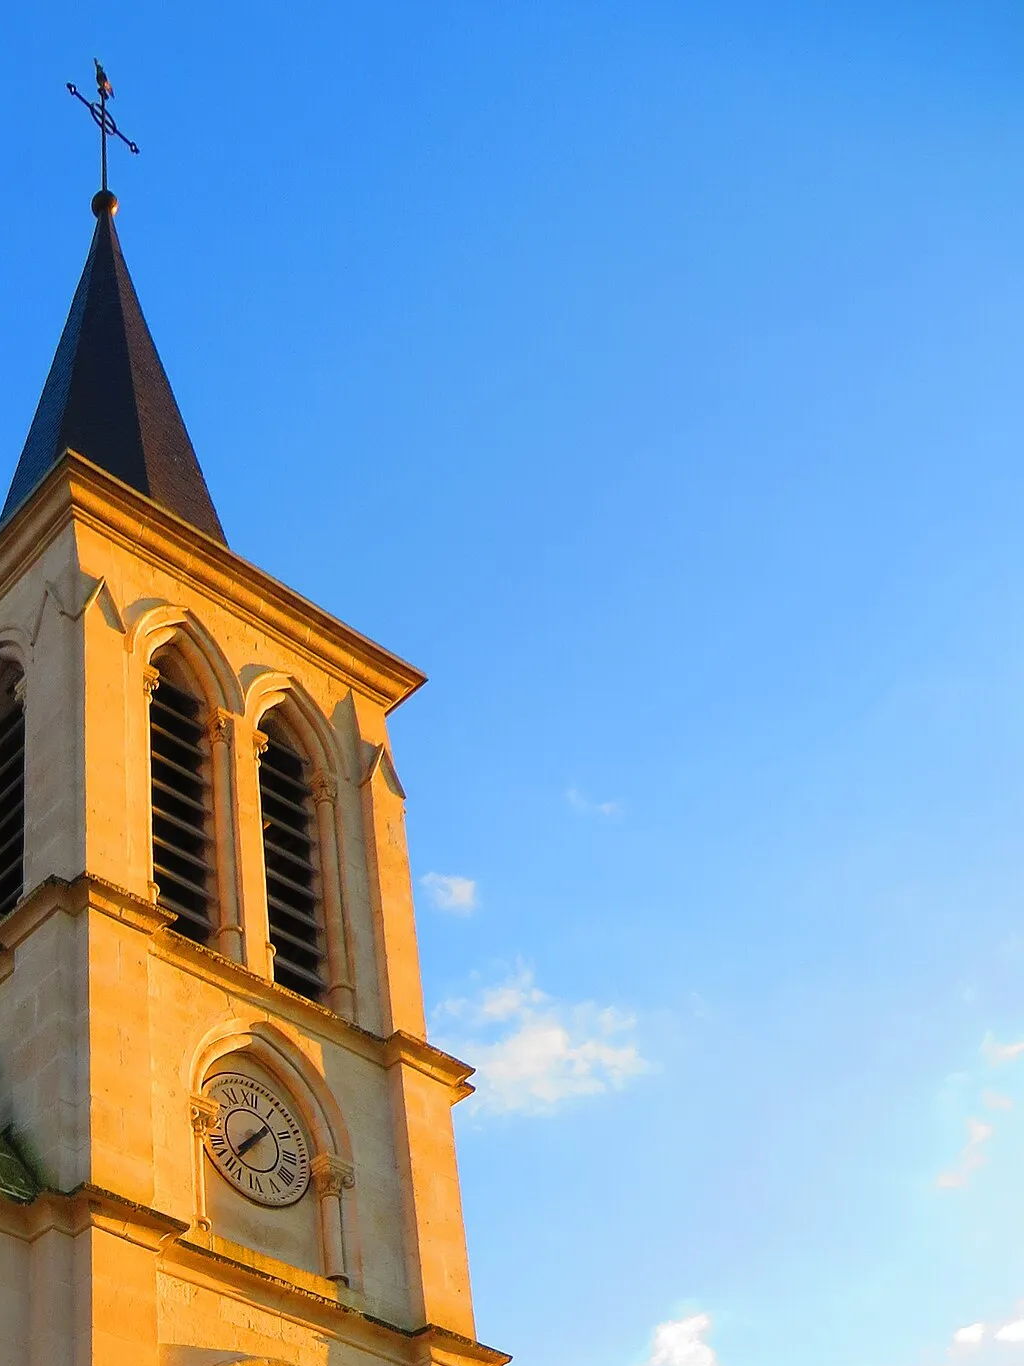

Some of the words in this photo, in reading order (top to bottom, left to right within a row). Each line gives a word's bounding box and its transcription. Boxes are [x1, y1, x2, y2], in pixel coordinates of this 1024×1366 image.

[222, 1087, 238, 1106] XI
[241, 1089, 258, 1109] XII
[277, 1130, 291, 1140] II
[209, 1134, 228, 1157] VIII
[282, 1150, 297, 1166] III
[224, 1156, 242, 1181] VII
[277, 1166, 295, 1187] IIII
[248, 1173, 264, 1193] VI
[269, 1178, 281, 1194] V
